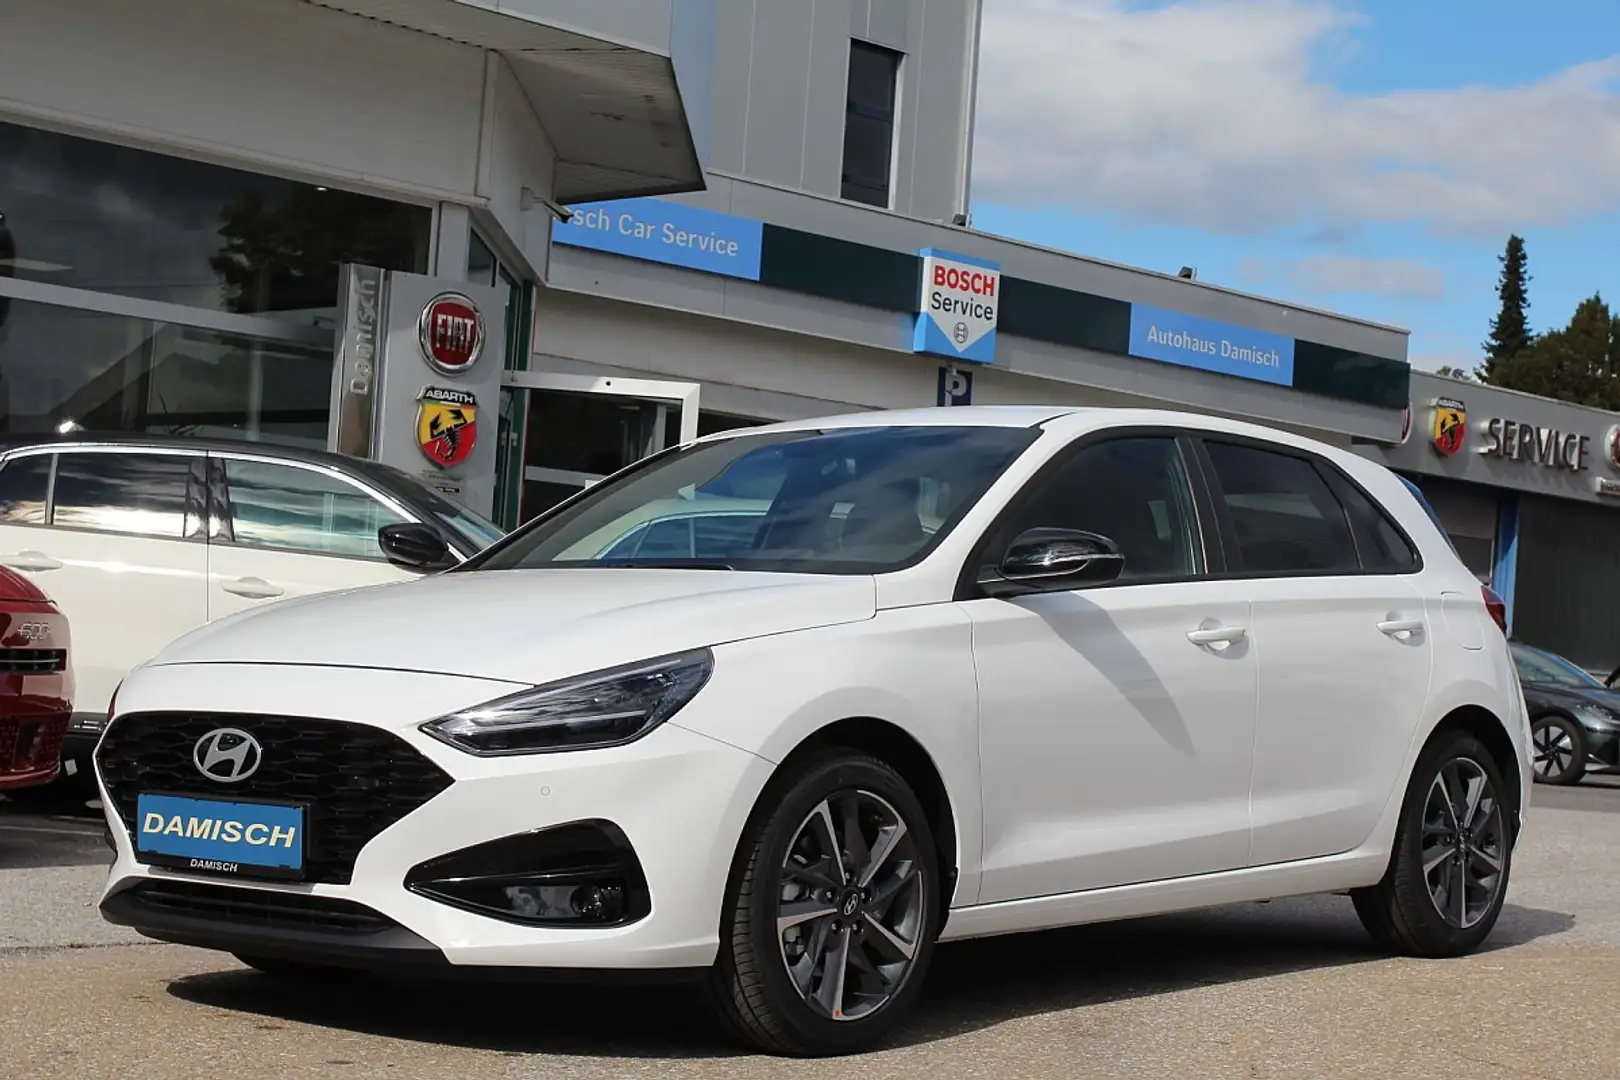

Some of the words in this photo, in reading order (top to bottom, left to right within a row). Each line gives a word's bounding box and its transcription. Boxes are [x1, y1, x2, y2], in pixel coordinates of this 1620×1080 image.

[555, 207, 610, 231] sch
[618, 213, 656, 240] Car
[661, 222, 739, 257] Service
[933, 264, 996, 297] BOSCH
[931, 291, 994, 321] Service
[350, 278, 376, 396] Damisch
[435, 312, 475, 354] FIAT
[1147, 325, 1217, 355] Autohaus
[1220, 339, 1280, 368] Damisch
[426, 389, 474, 404] ABARTH
[1484, 418, 1590, 471] SERVICE
[142, 812, 297, 848] DAMISCH
[189, 858, 239, 873] DAMISCH
